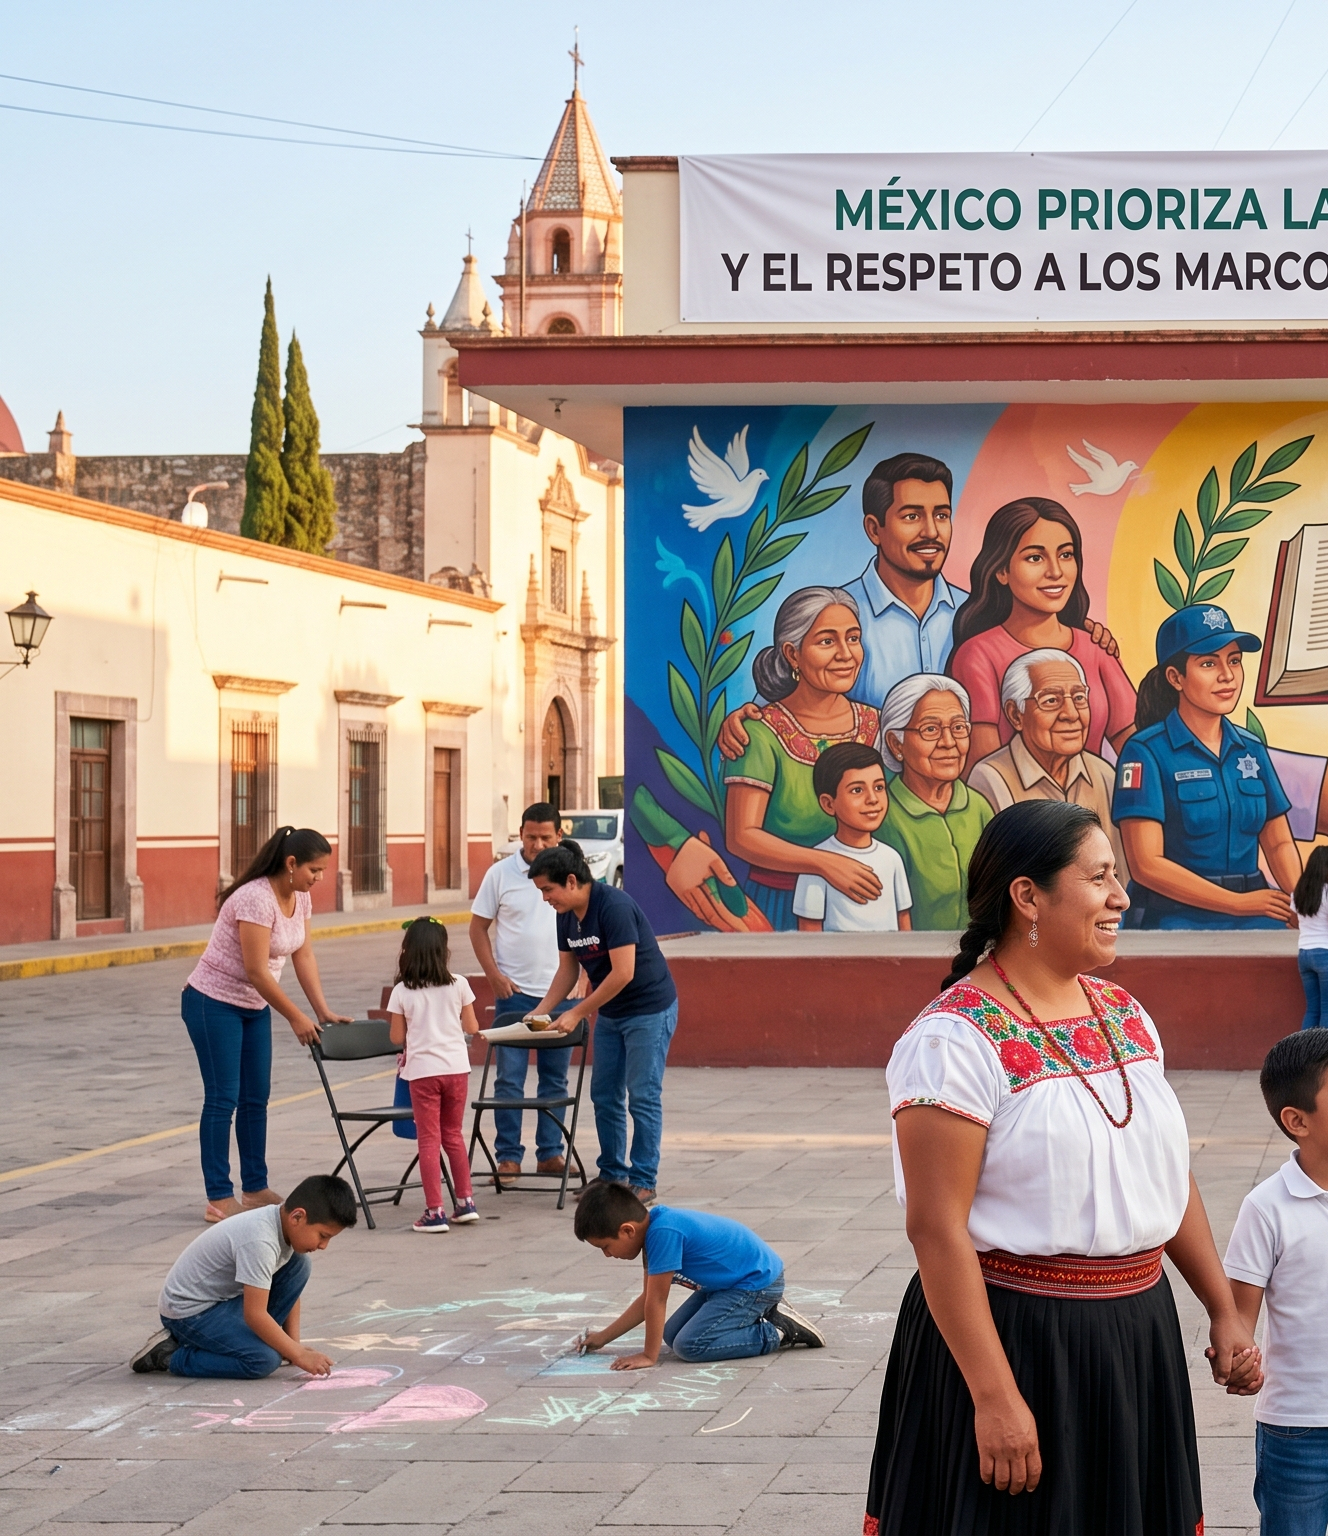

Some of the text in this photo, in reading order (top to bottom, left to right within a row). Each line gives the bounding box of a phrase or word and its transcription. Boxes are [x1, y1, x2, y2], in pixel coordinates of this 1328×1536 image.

[835, 176, 1022, 231] MÉXICO
[1038, 187, 1268, 231] PRIORIZA
[720, 253, 750, 292] Y
[763, 252, 813, 292] EL
[826, 252, 1022, 292] RESPETO
[1033, 252, 1066, 291] A
[1079, 251, 1161, 292] LOS
